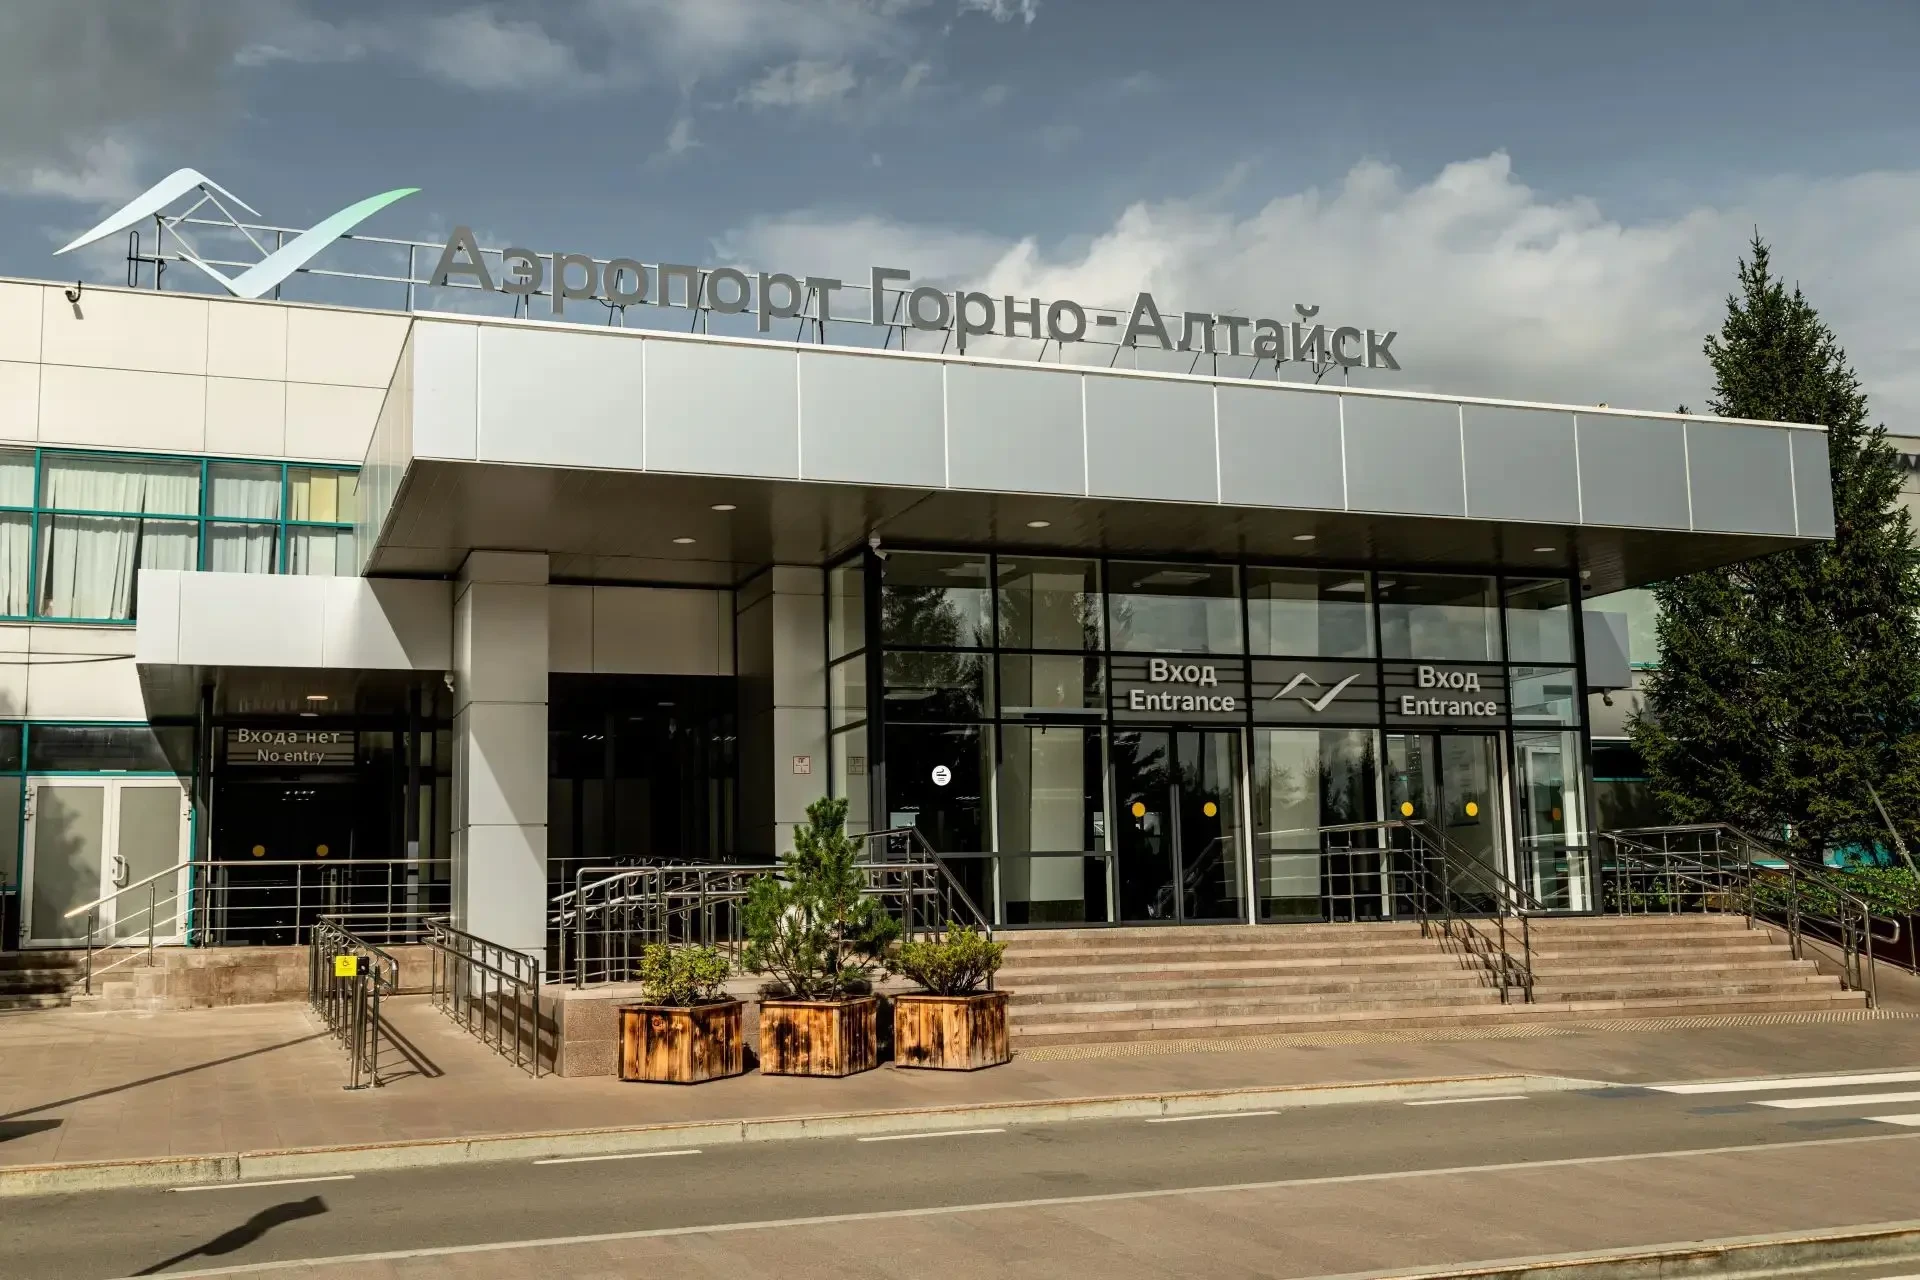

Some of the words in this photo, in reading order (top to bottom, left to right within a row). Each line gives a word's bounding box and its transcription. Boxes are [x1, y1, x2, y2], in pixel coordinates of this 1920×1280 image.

[429, 226, 842, 332] Аэропорт
[871, 267, 1401, 370] Горно-Алтайск
[1149, 658, 1217, 687] Вход
[1418, 665, 1481, 692] Вход
[1129, 689, 1236, 713] Entrance
[1402, 695, 1498, 717] Entrance
[238, 728, 298, 745] Входа
[306, 732, 340, 744] нет
[257, 749, 280, 762] No
[284, 750, 325, 765] entry
